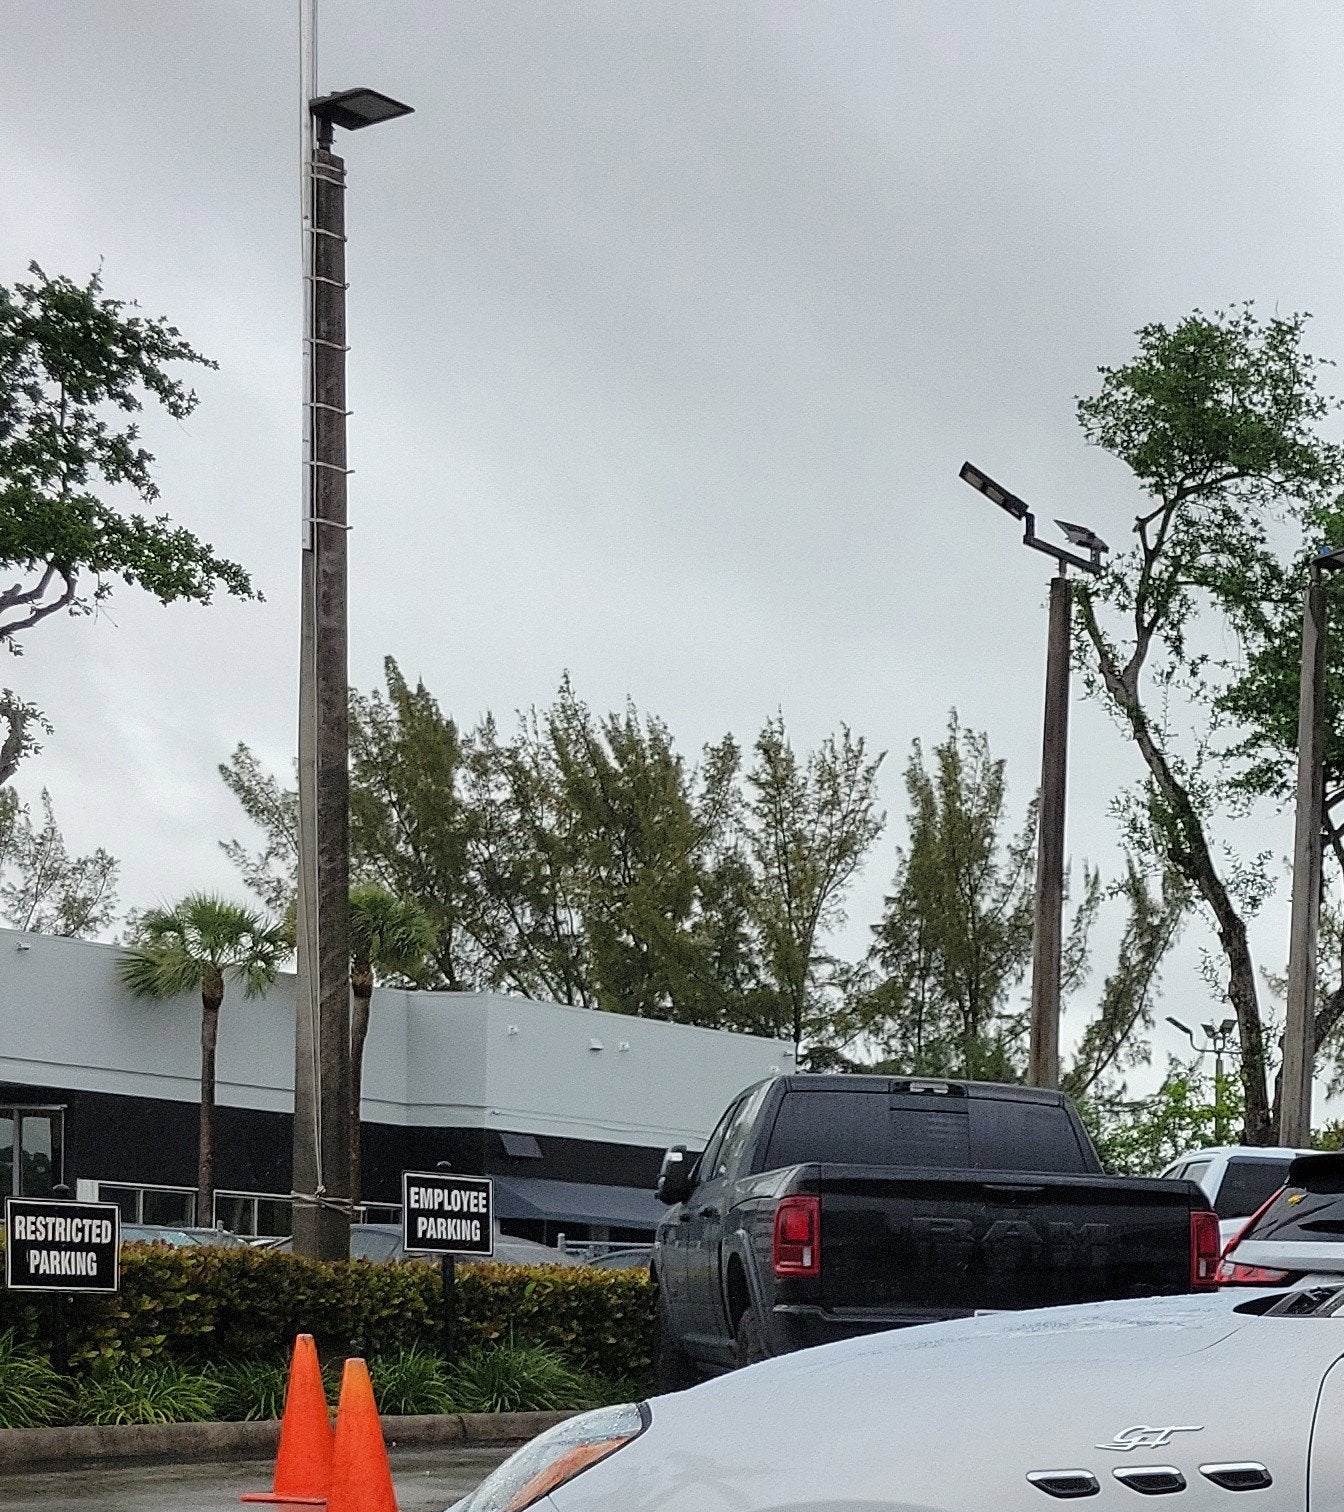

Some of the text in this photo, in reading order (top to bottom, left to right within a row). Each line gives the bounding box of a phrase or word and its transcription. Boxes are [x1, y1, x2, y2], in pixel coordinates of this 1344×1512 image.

[410, 1186, 487, 1213] EMPLOYEE
[15, 1215, 112, 1244] RESTRICTED
[417, 1216, 480, 1242] PARKING
[912, 1216, 1110, 1266] RAM
[29, 1249, 97, 1276] PARKING
[1094, 1425, 1204, 1452] GT
